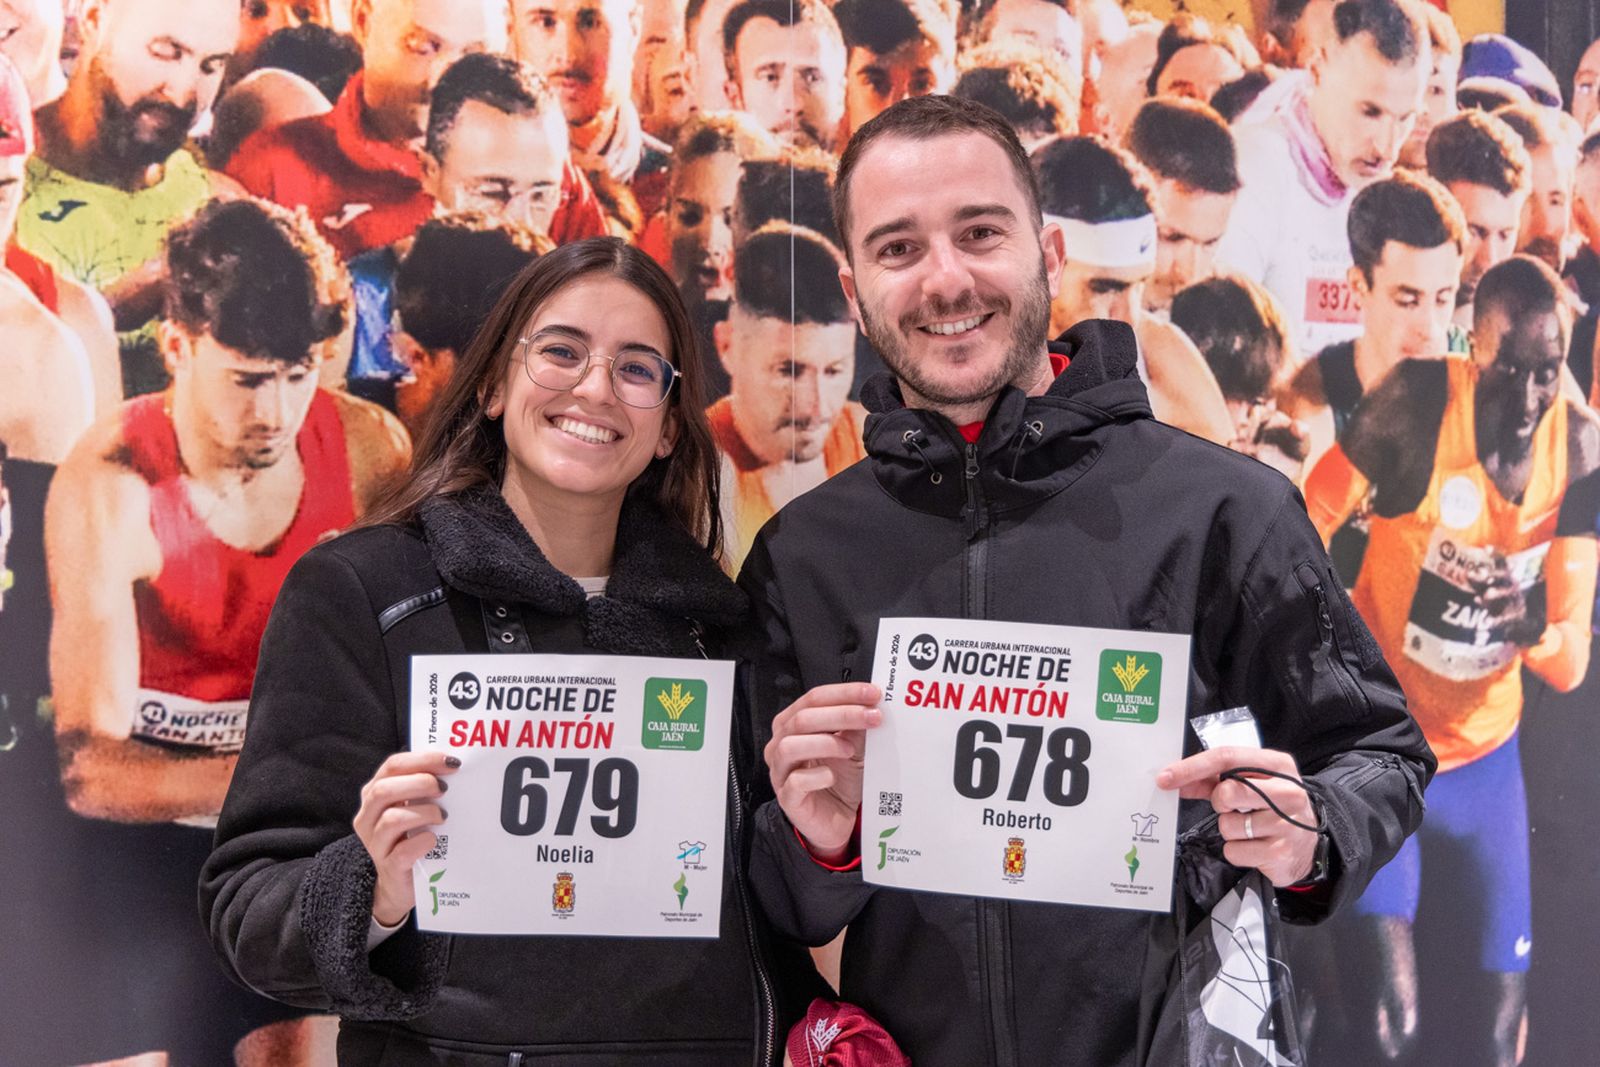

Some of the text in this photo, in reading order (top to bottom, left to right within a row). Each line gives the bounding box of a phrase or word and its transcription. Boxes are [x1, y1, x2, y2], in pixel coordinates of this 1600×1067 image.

[909, 642, 937, 660] 43
[944, 639, 1072, 656] CARRERA URBANA INTERNACIONAL
[885, 634, 900, 701] 17 Enero de 2026
[942, 650, 1072, 682] NOCHE DE
[449, 680, 479, 699] 43
[486, 675, 616, 686] CARRERA URBANA INTERNACIONAL
[428, 673, 438, 744] 17 Enero de 2026
[486, 687, 617, 713] NOCHE DE
[904, 680, 1069, 718] SAN ANTÓN
[1102, 693, 1155, 706] CAJA RURAL
[170, 711, 238, 728] NOCHE
[449, 713, 615, 749] SAN ANTÓN
[647, 721, 700, 733] CAJA RURAL
[953, 719, 1091, 807] 678
[500, 756, 640, 839] 679
[983, 808, 1052, 831] Roberto
[536, 844, 594, 863] Noelia
